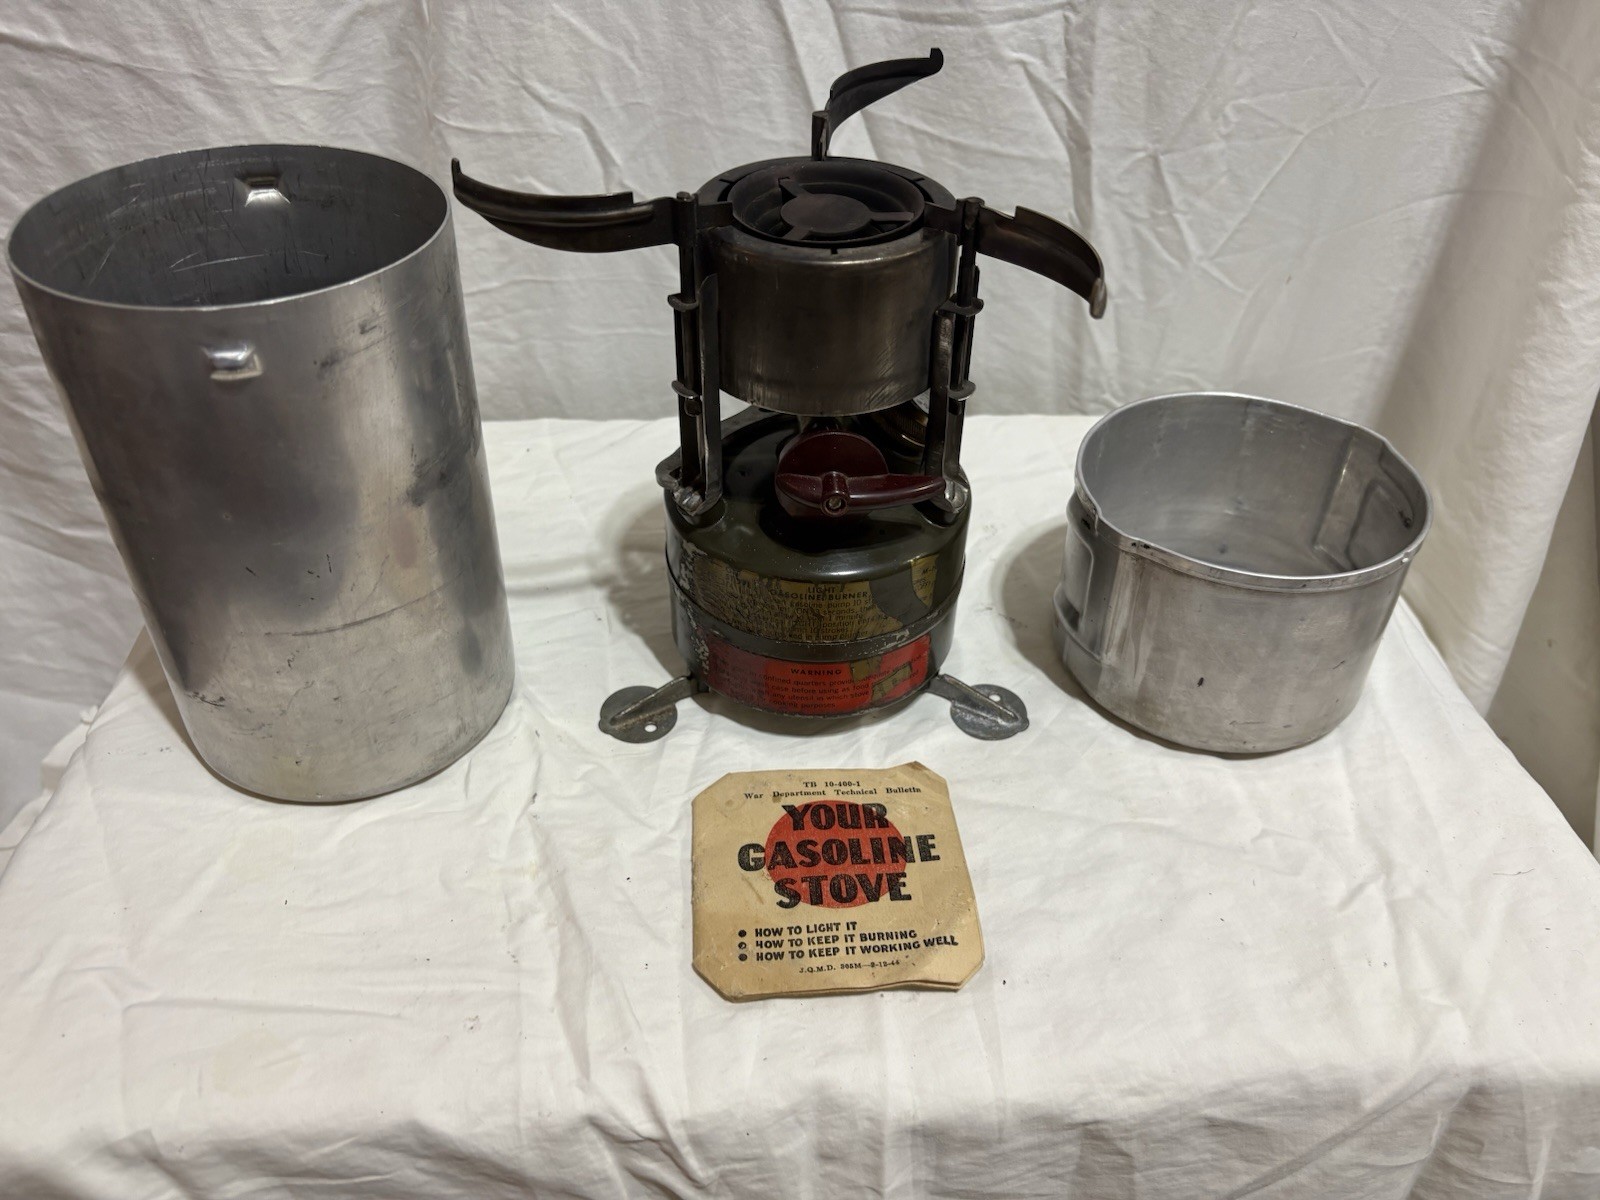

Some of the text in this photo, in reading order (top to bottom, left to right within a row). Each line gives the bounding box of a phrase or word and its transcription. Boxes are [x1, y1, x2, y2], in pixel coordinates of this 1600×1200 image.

[769, 589, 868, 601] GASOLINE BURNER
[808, 586, 835, 594] LIGHT
[790, 668, 842, 676] WARNING
[793, 679, 826, 687] quarters
[791, 687, 816, 695] before
[824, 780, 862, 788] 10-400-1
[744, 785, 922, 800] War Department Technical Bulletin
[782, 803, 889, 830] YOUR
[738, 834, 941, 871] GASOLINE
[774, 871, 912, 909] STOVE
[754, 921, 858, 938] HOW TO LIGHT IT
[755, 929, 918, 949] HOW TO KEEP IT BURNING
[756, 934, 960, 962] HOW TO KEEP IT WORKING WELL
